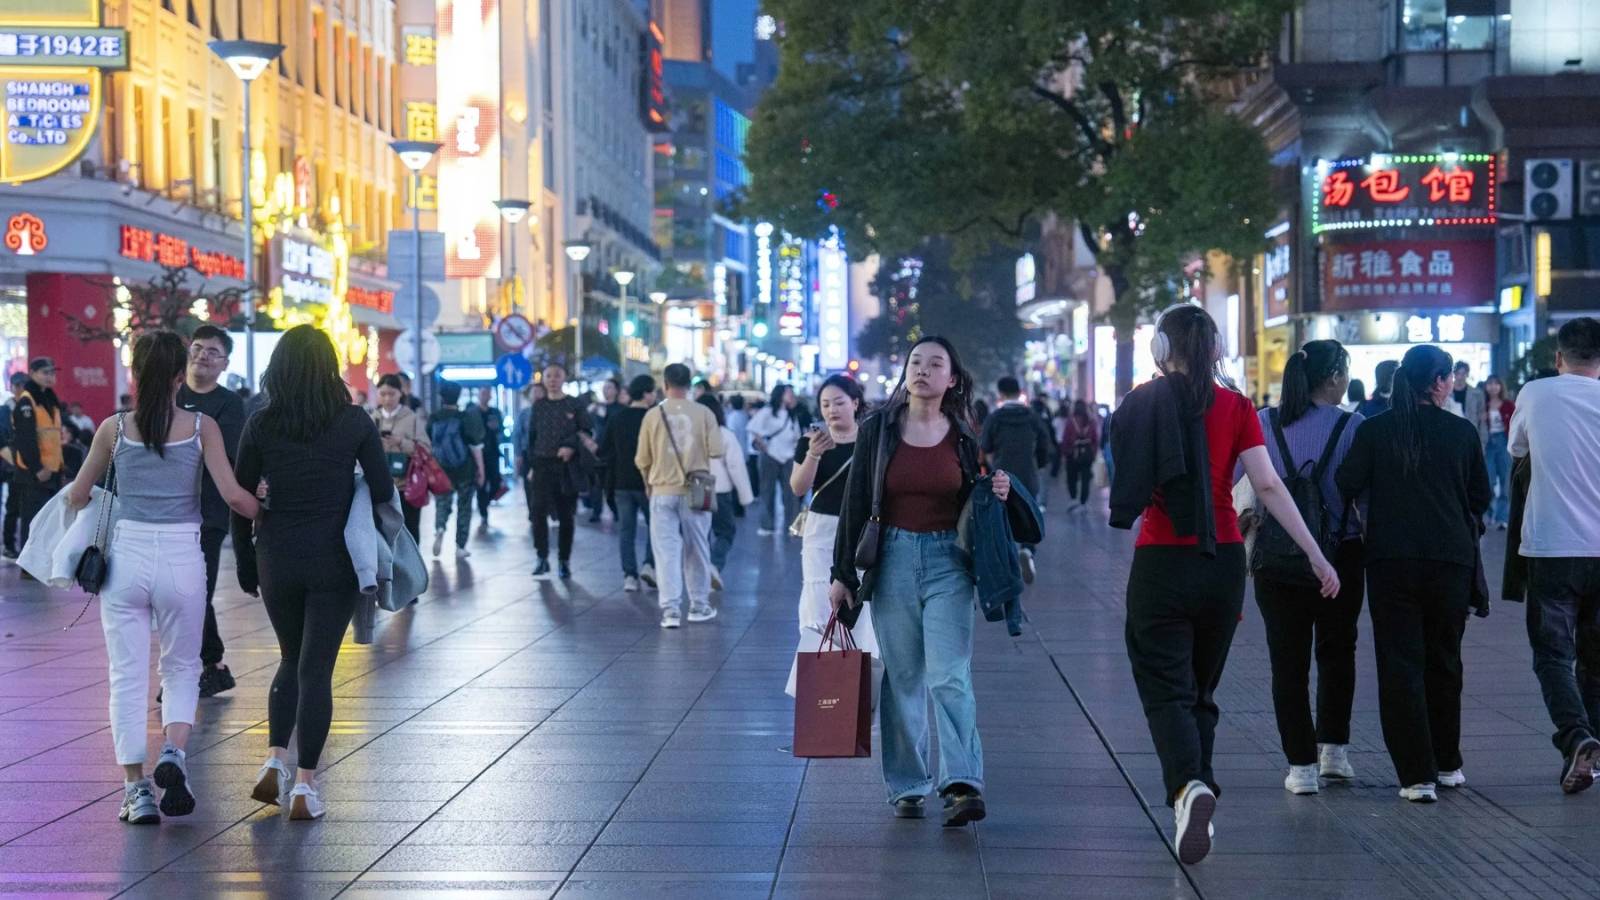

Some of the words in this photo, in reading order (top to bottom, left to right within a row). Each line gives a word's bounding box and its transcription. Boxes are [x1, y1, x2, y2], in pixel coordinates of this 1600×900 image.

[7, 81, 90, 96] SHANGHI
[1323, 166, 1475, 207] 汤包馆
[1331, 249, 1454, 280] 新雅食品
